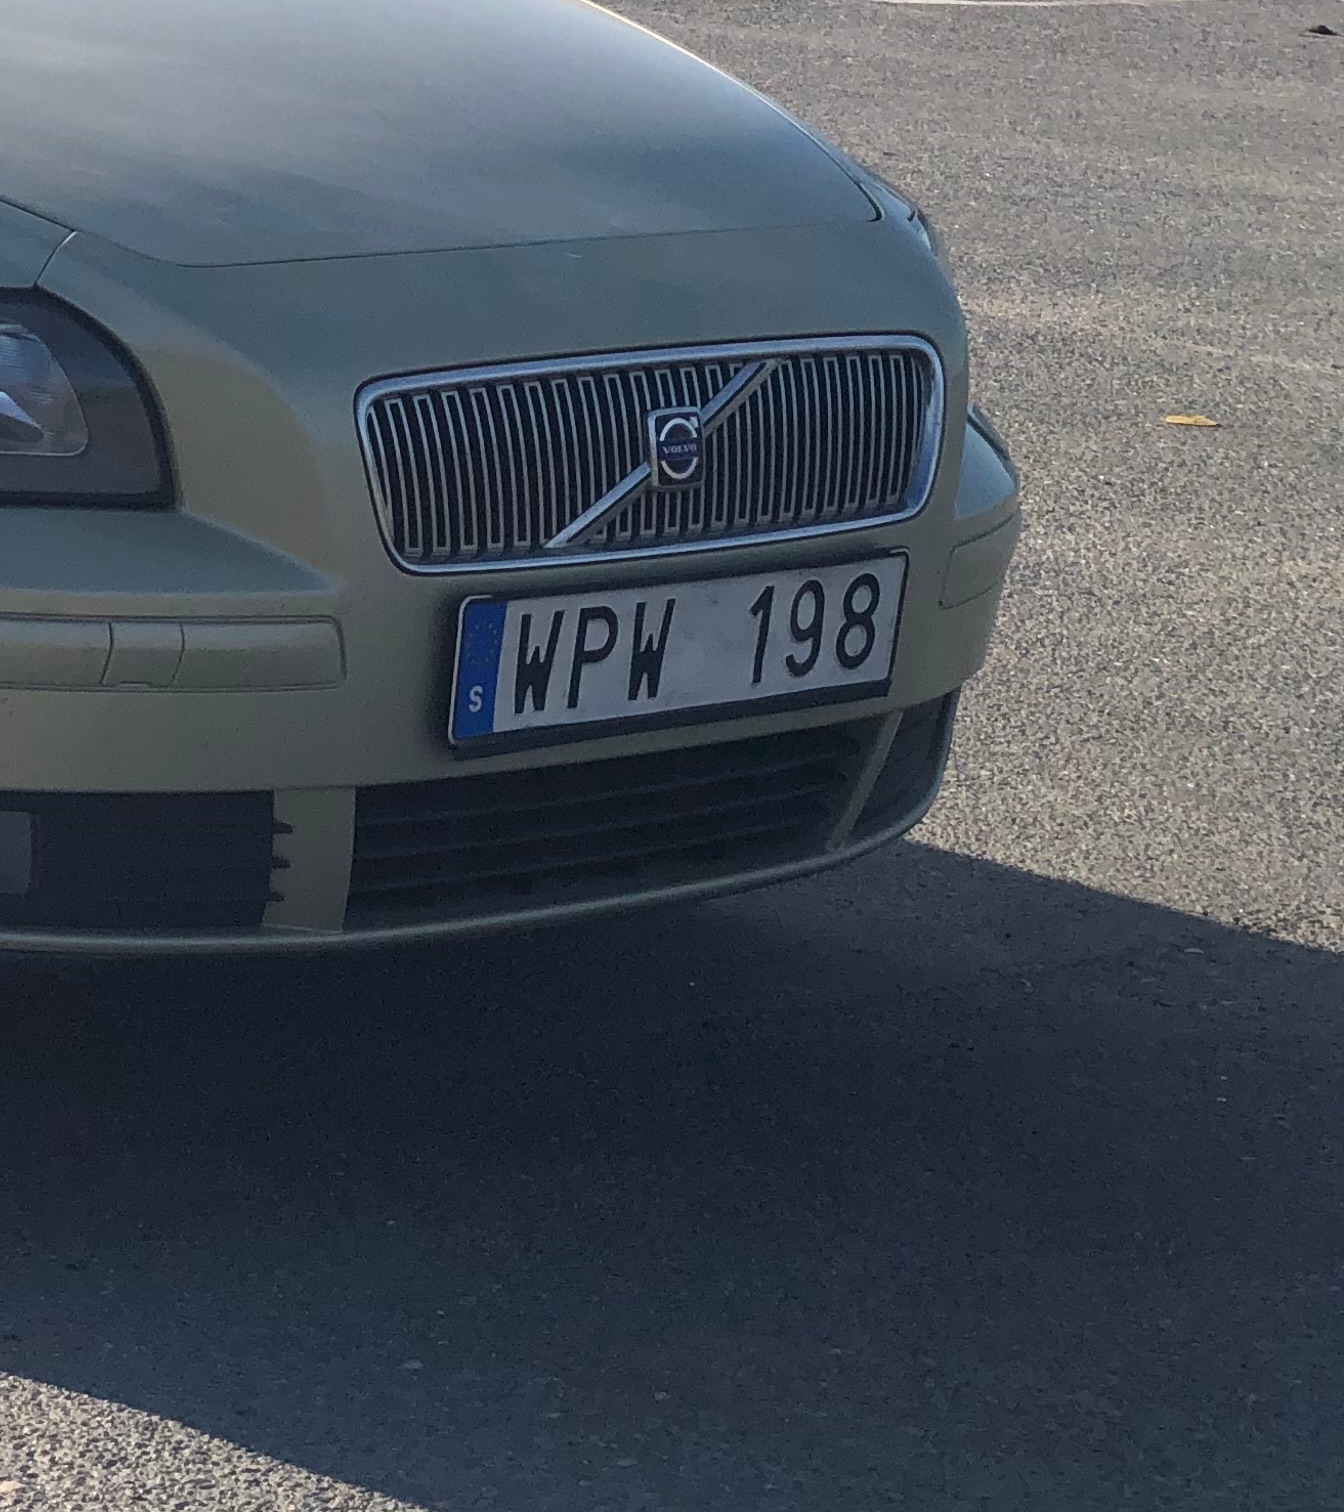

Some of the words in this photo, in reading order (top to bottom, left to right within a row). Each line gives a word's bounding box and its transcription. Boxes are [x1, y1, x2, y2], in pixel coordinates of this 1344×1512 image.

[663, 443, 697, 454] VOLVO
[514, 598, 676, 714] WPW
[750, 573, 880, 687] 198
[468, 685, 484, 713] S
